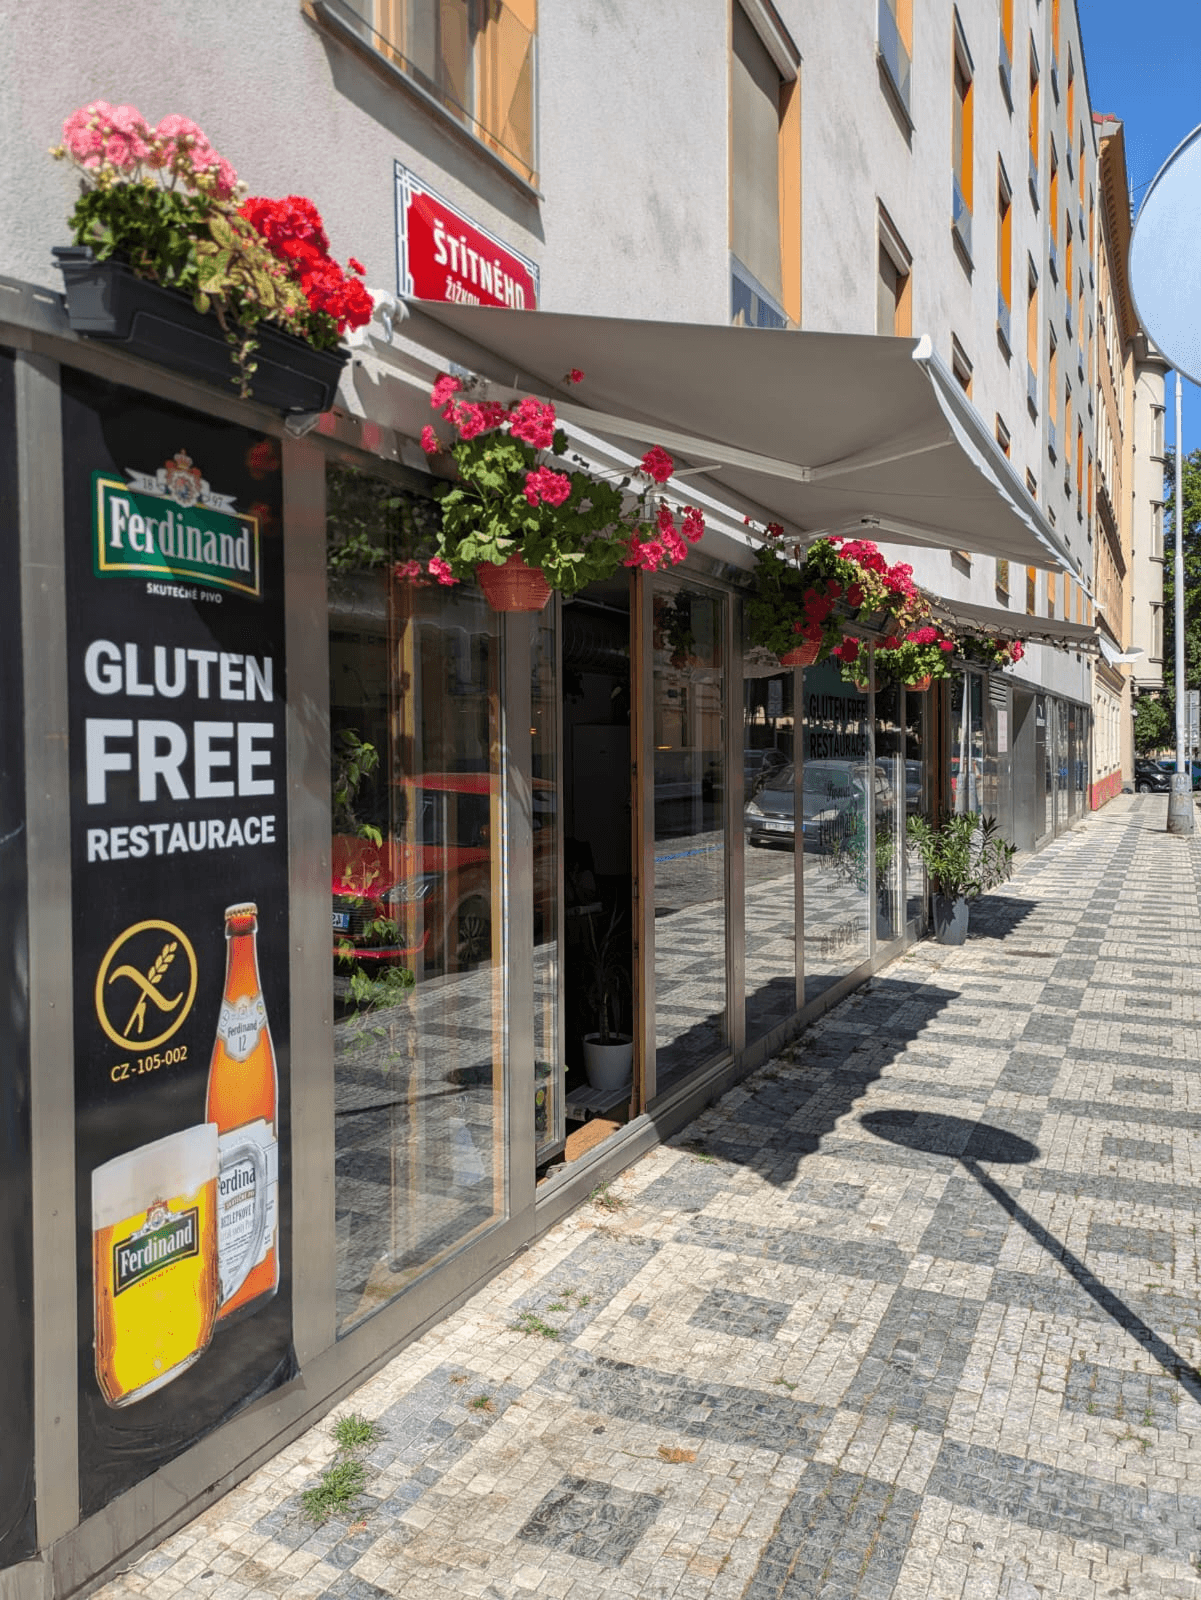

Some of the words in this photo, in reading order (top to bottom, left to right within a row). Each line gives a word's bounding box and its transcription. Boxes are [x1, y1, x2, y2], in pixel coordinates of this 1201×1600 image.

[433, 217, 525, 310] ŠTÍTNÉHO
[109, 496, 251, 572] Ferdinand
[146, 582, 198, 600] SKUTEČNÉ
[200, 591, 223, 604] PIVO
[84, 639, 273, 702] GLUTEN
[85, 718, 275, 805] FREE
[87, 815, 276, 863] RESTAURACE
[227, 1019, 257, 1038] Ferdinand
[238, 1034, 247, 1053] 12
[110, 1045, 188, 1083] CZ-105-002
[219, 1167, 256, 1196] erdina
[120, 1218, 193, 1277] Ferdinand
